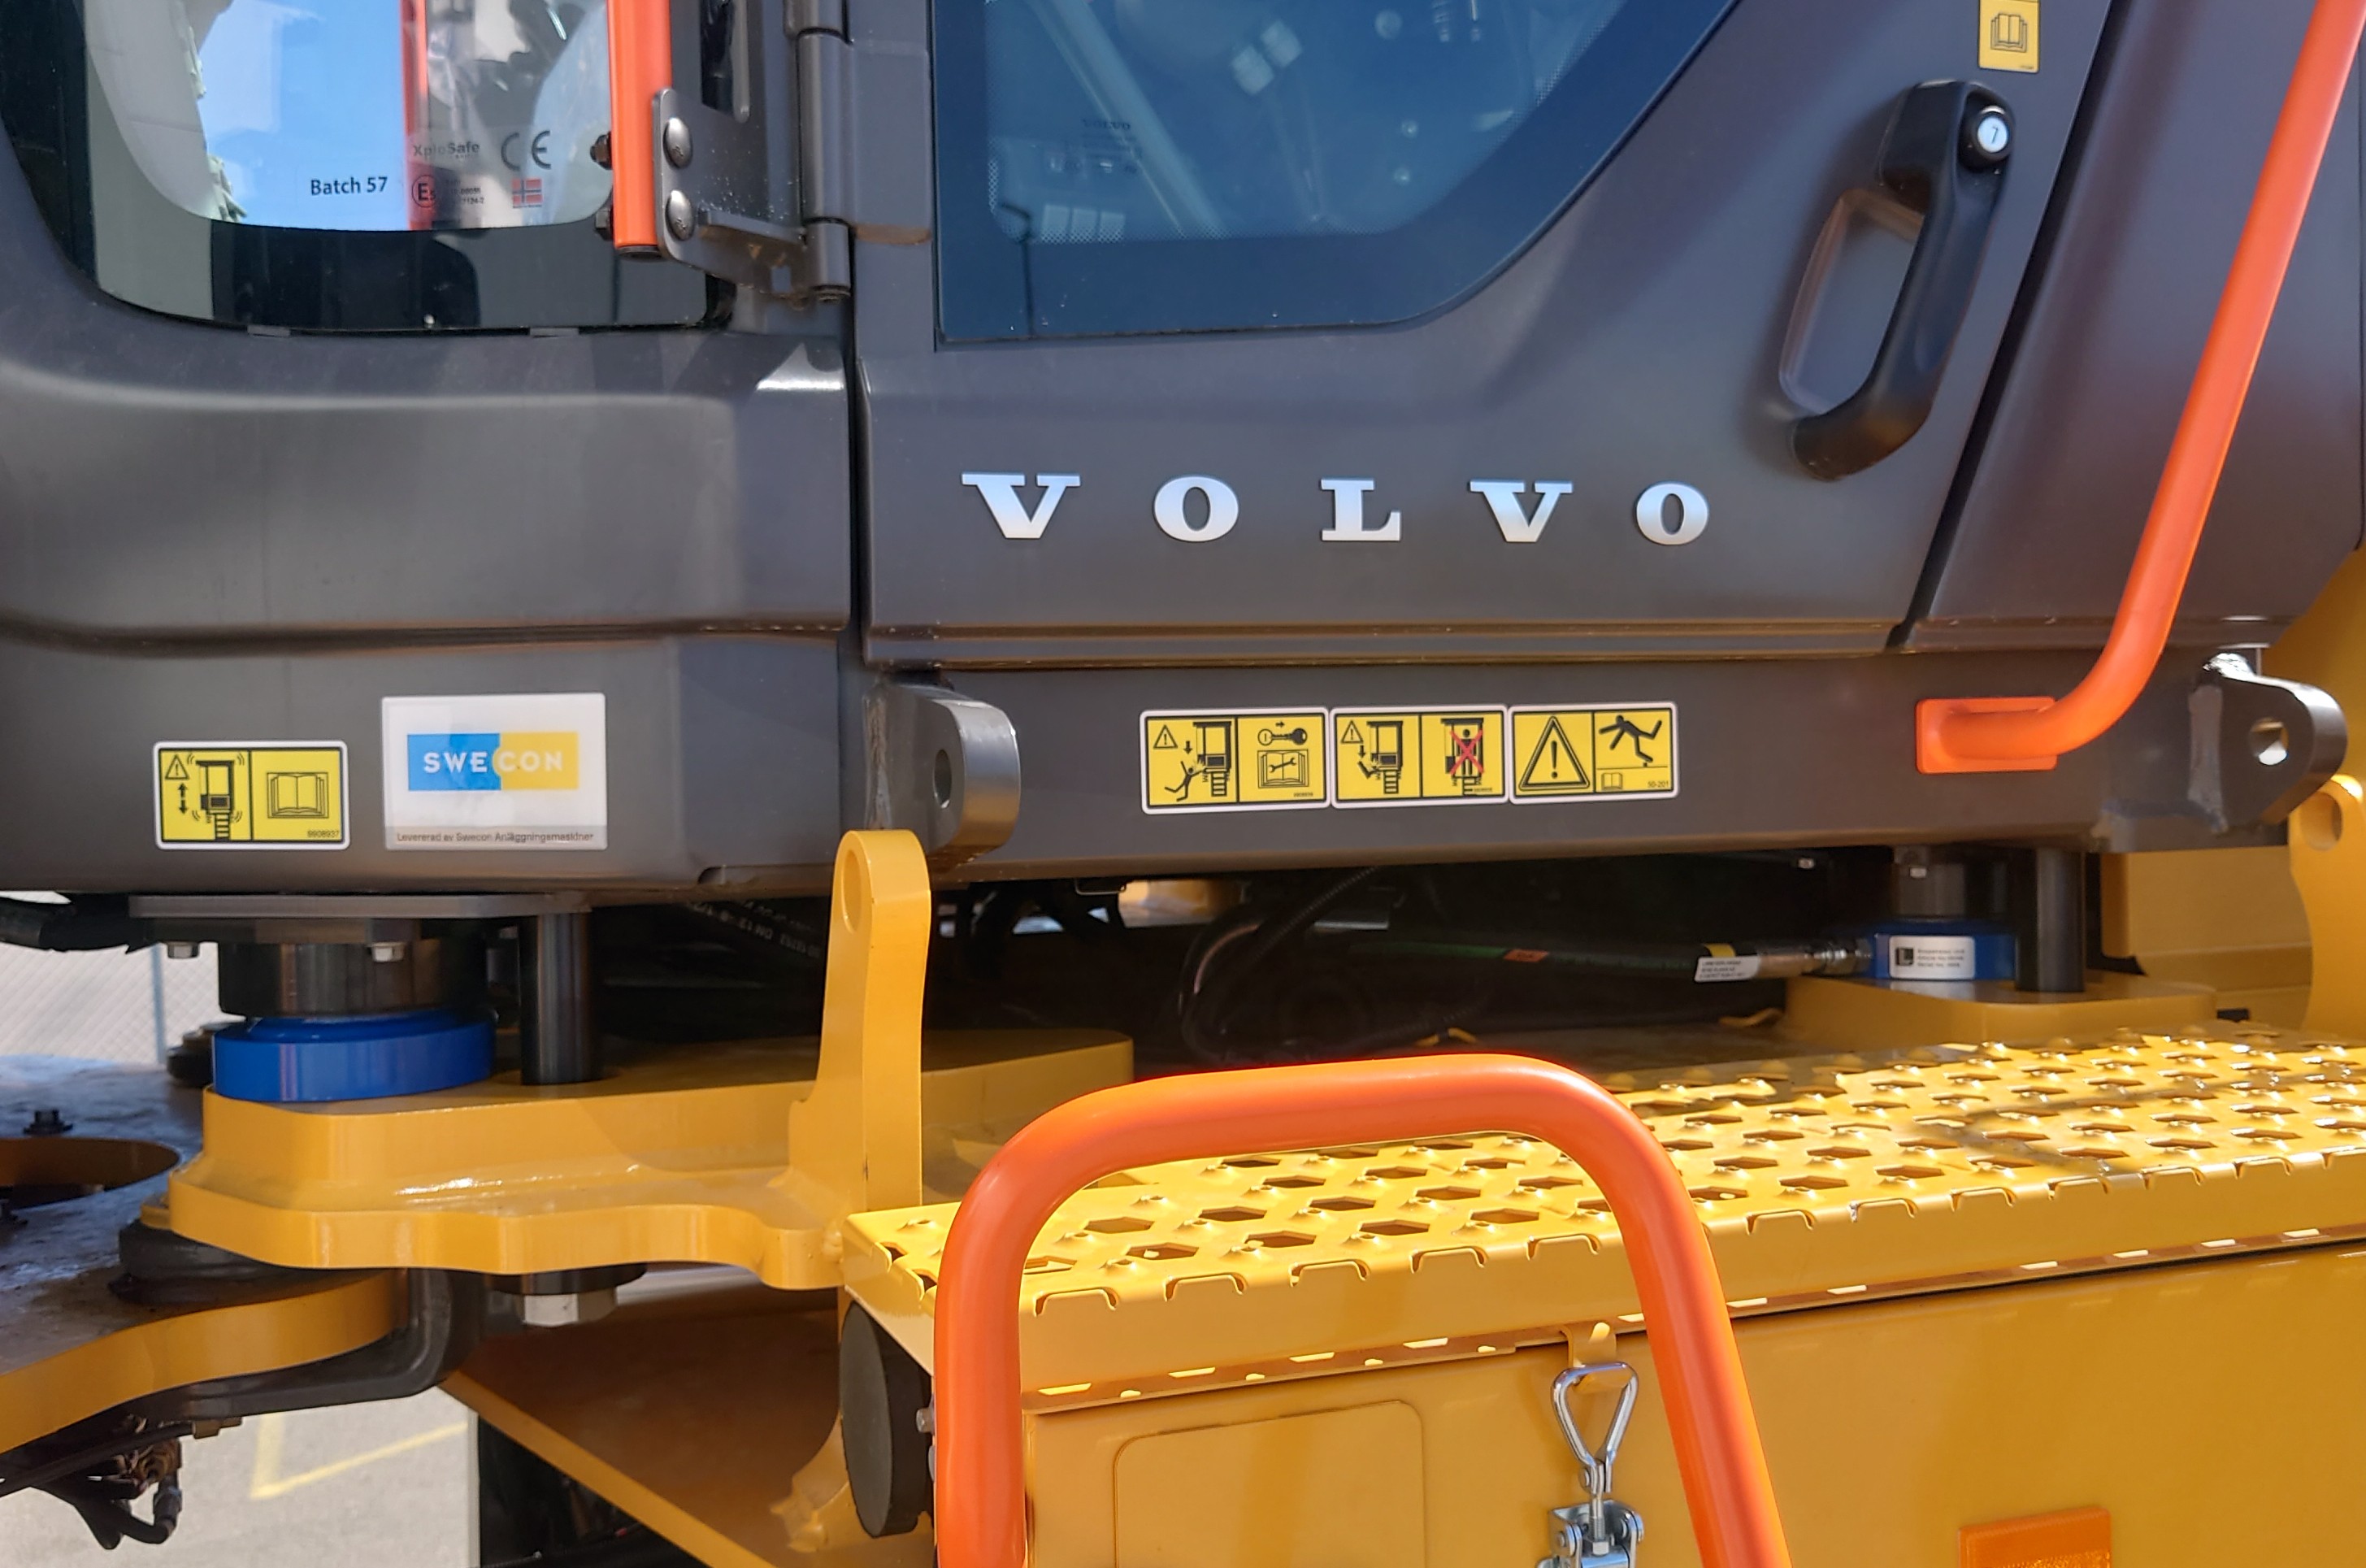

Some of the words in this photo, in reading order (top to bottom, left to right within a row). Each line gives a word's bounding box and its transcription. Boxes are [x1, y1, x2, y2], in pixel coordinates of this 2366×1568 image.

[310, 176, 360, 196] Batch
[367, 176, 388, 193] 57
[962, 471, 1709, 545] VOLVO
[423, 750, 563, 773] SWECON
[397, 832, 441, 842] Levererad
[444, 834, 454, 842] av
